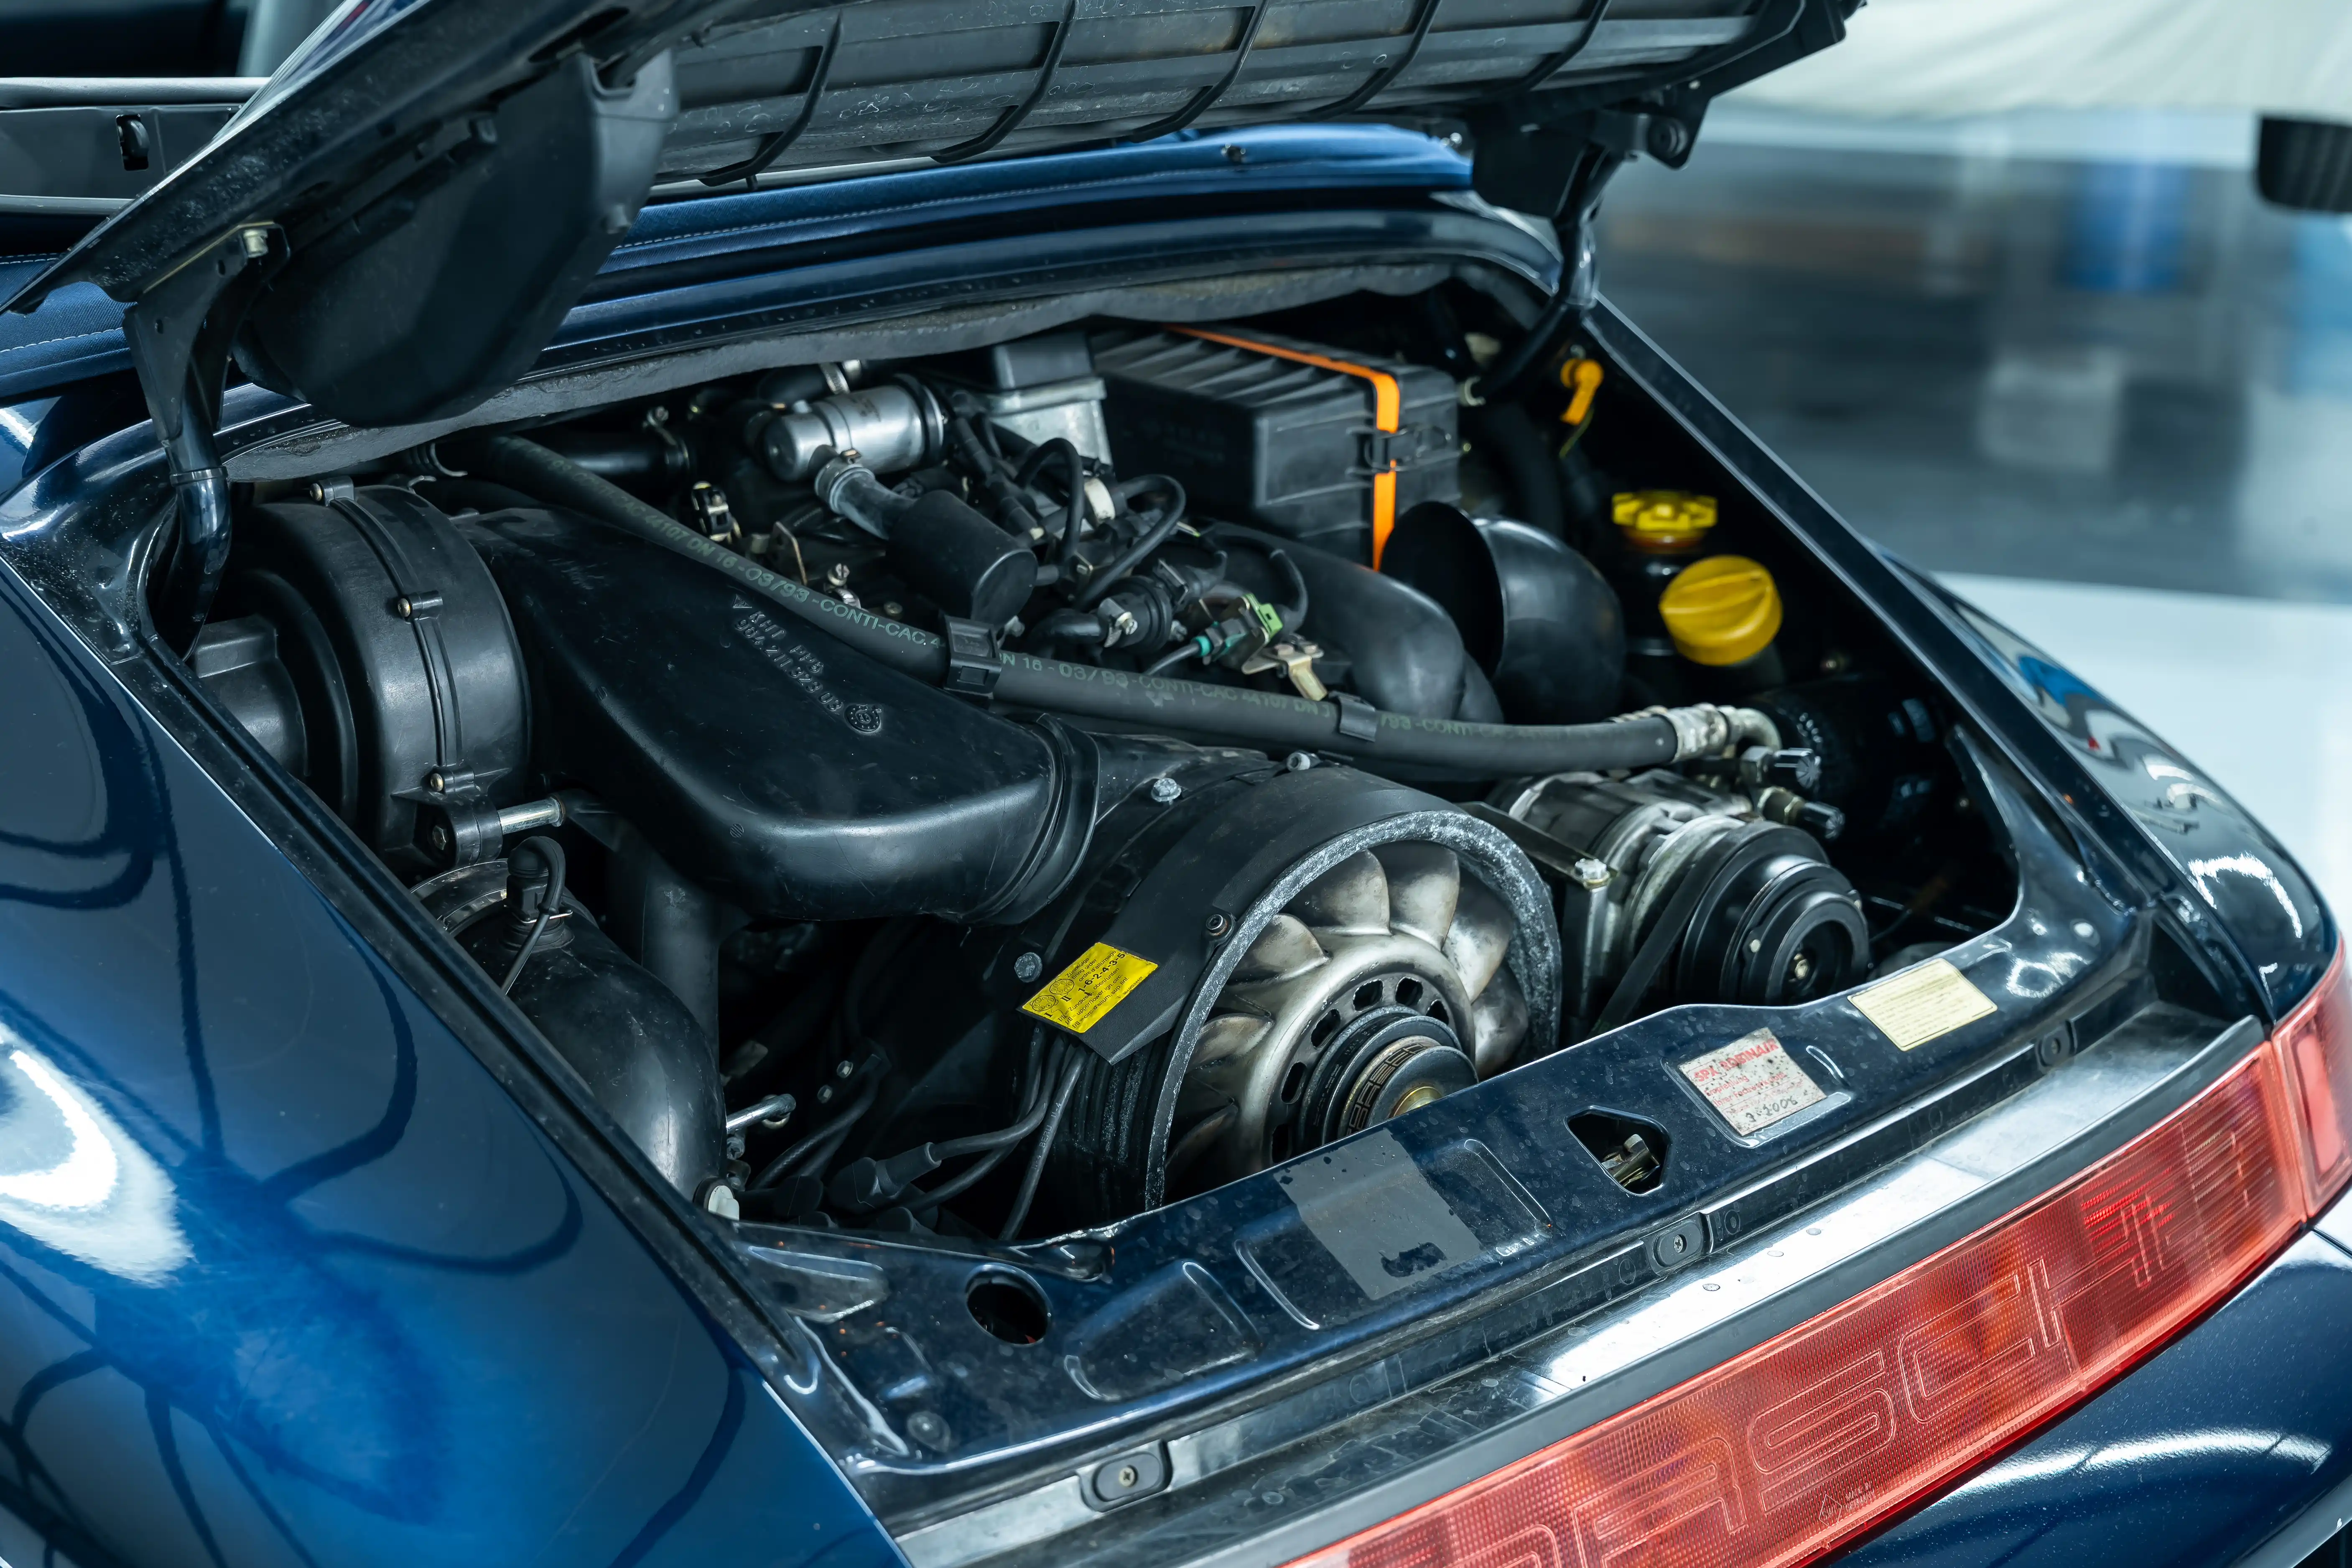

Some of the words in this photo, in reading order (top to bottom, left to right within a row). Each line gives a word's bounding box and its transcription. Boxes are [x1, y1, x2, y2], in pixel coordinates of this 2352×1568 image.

[687, 537, 716, 556] DN
[715, 552, 737, 568] 16
[1071, 969, 1086, 979] firing
[1084, 959, 1097, 969] order
[1077, 951, 1126, 991] 1-6-2-4-3-5
[1078, 970, 1091, 982] ordre
[1090, 950, 1116, 971] d'allumage
[1093, 967, 1119, 990] oben/unten
[1693, 1065, 1720, 1083] SPX
[1718, 1038, 1779, 1072] ROBINAIR
[1039, 1125, 1052, 1147] BERU
